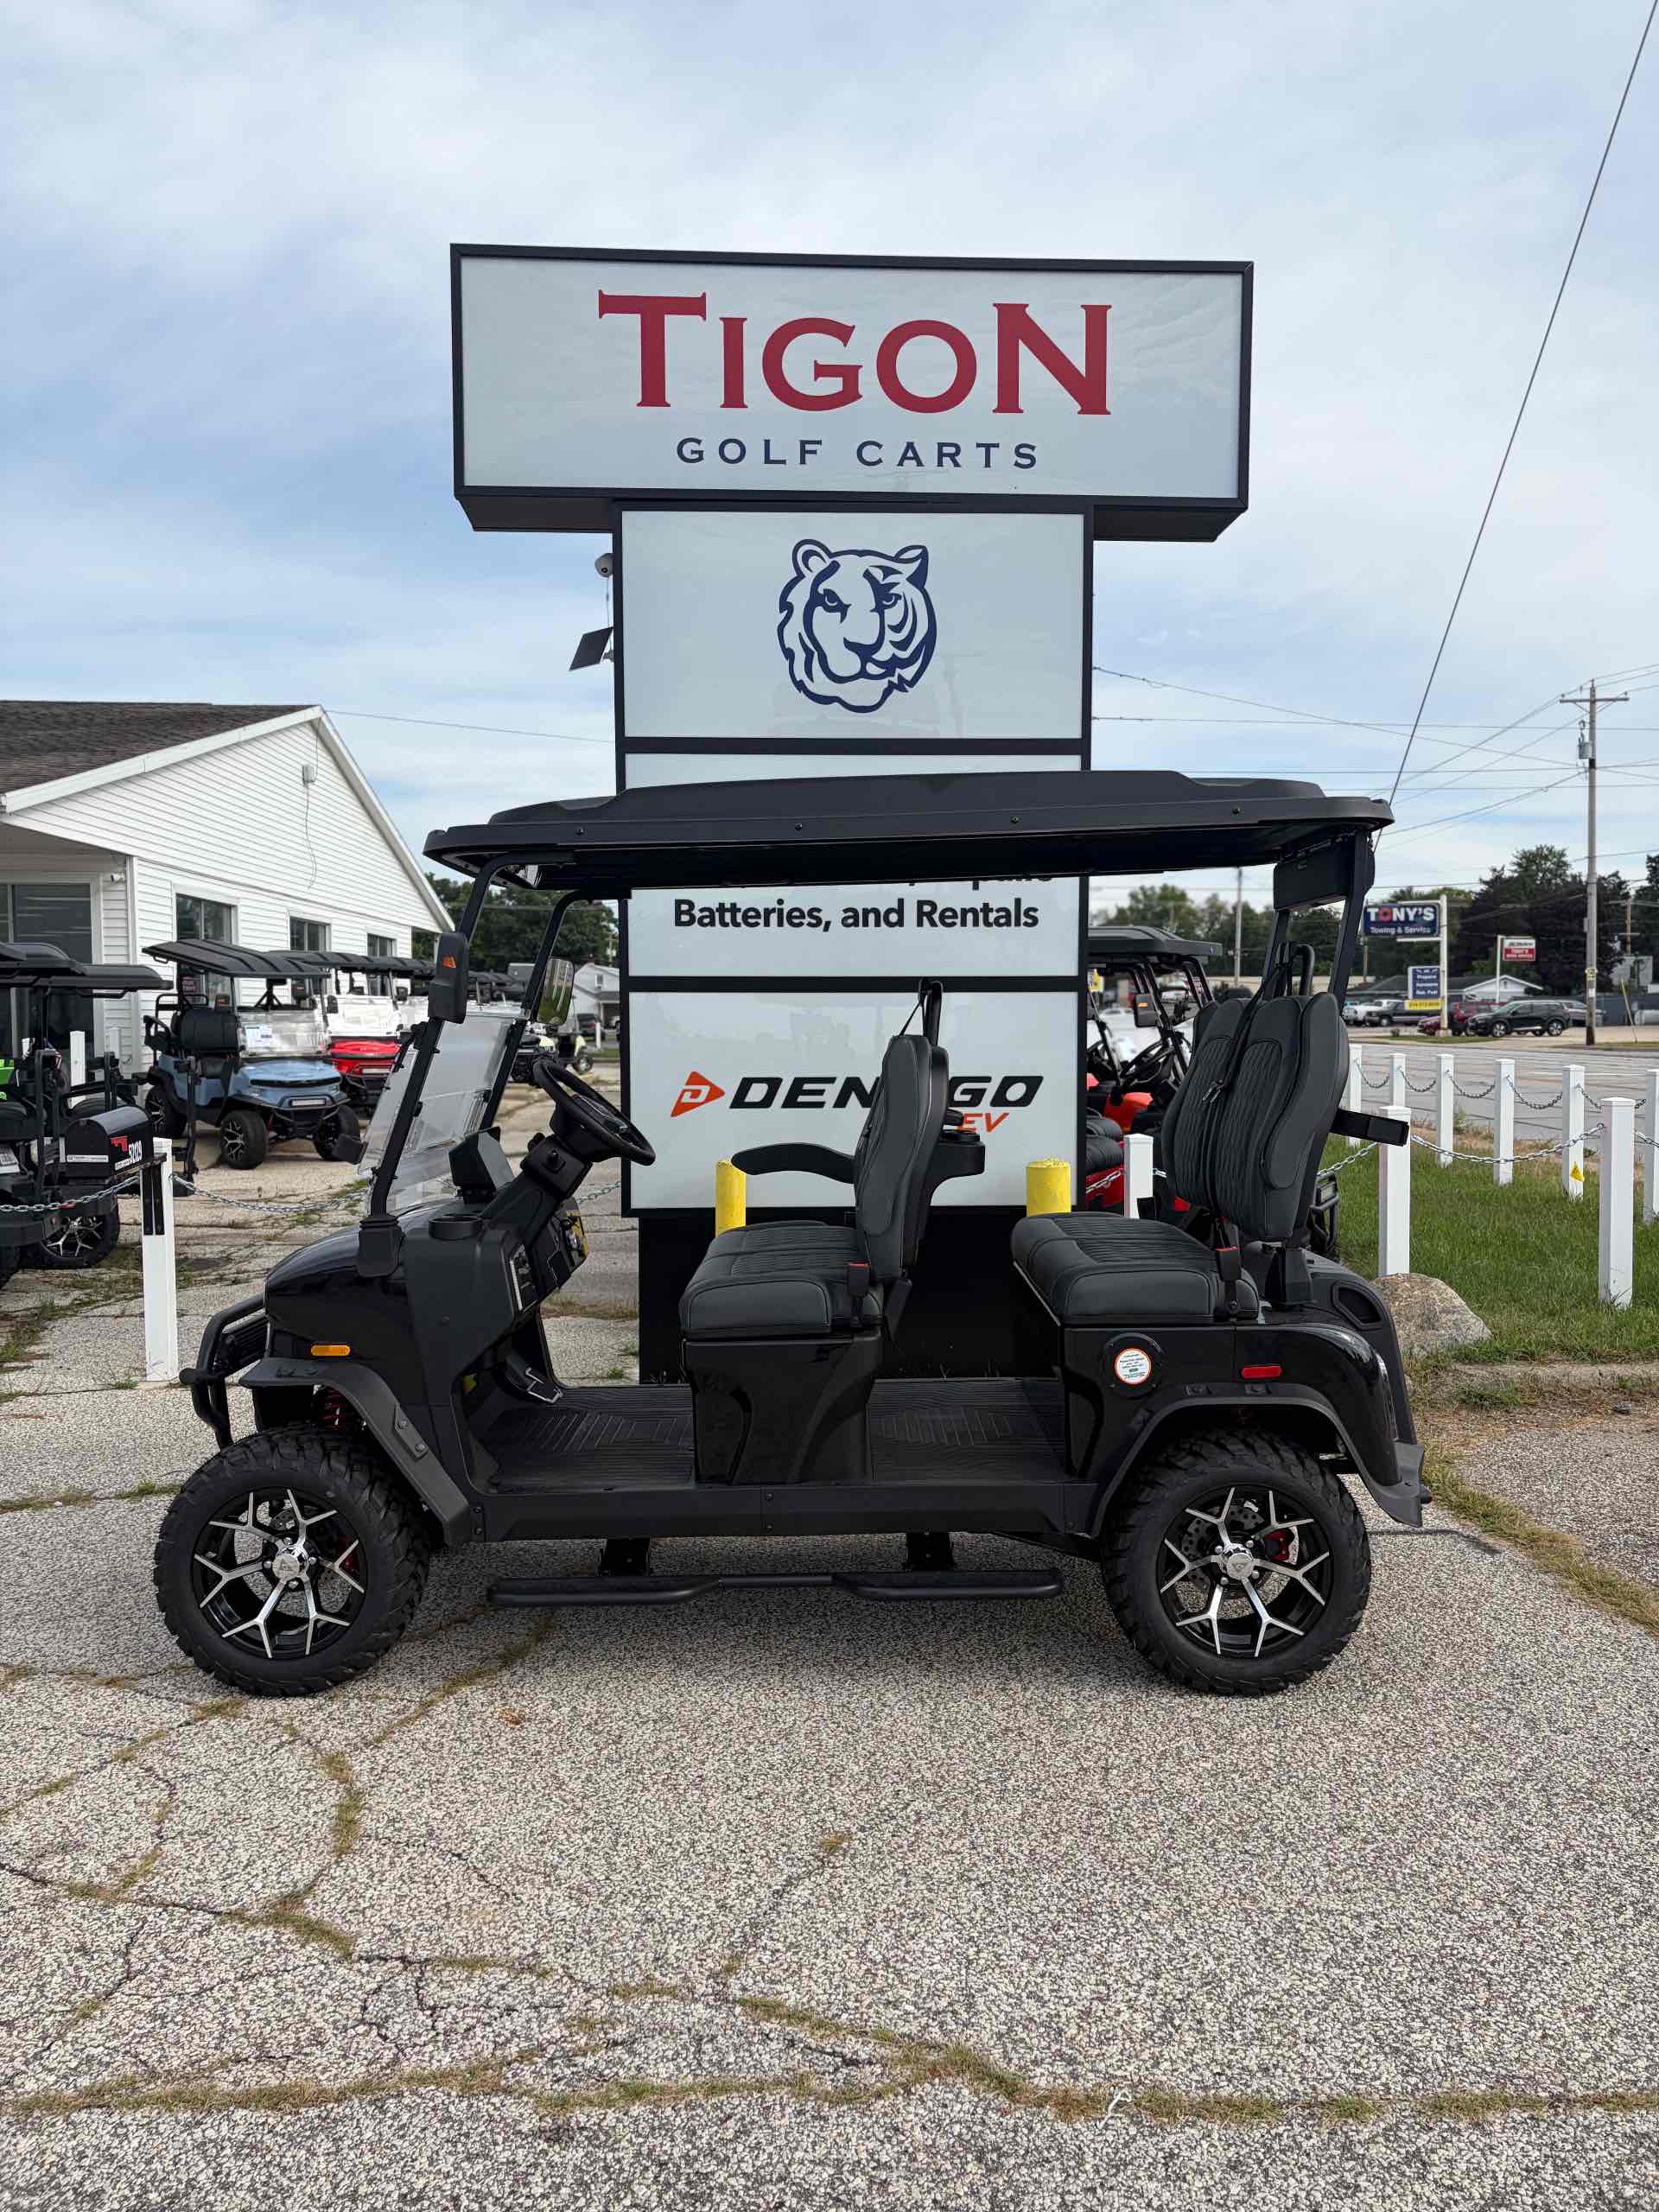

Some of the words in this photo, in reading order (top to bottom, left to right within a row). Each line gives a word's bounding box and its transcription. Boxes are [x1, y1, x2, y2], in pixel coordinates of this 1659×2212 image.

[598, 289, 1112, 416] TIGON
[677, 437, 822, 465] GOLF
[855, 440, 1037, 469] CARTS
[674, 898, 831, 932] Batteries,
[841, 899, 905, 928] and
[916, 898, 1039, 928] Rentals
[1367, 907, 1434, 922] TONY'S
[1370, 926, 1395, 935] Towing
[729, 1076, 1044, 1109] DENGO
[957, 1112, 1009, 1133] EV
